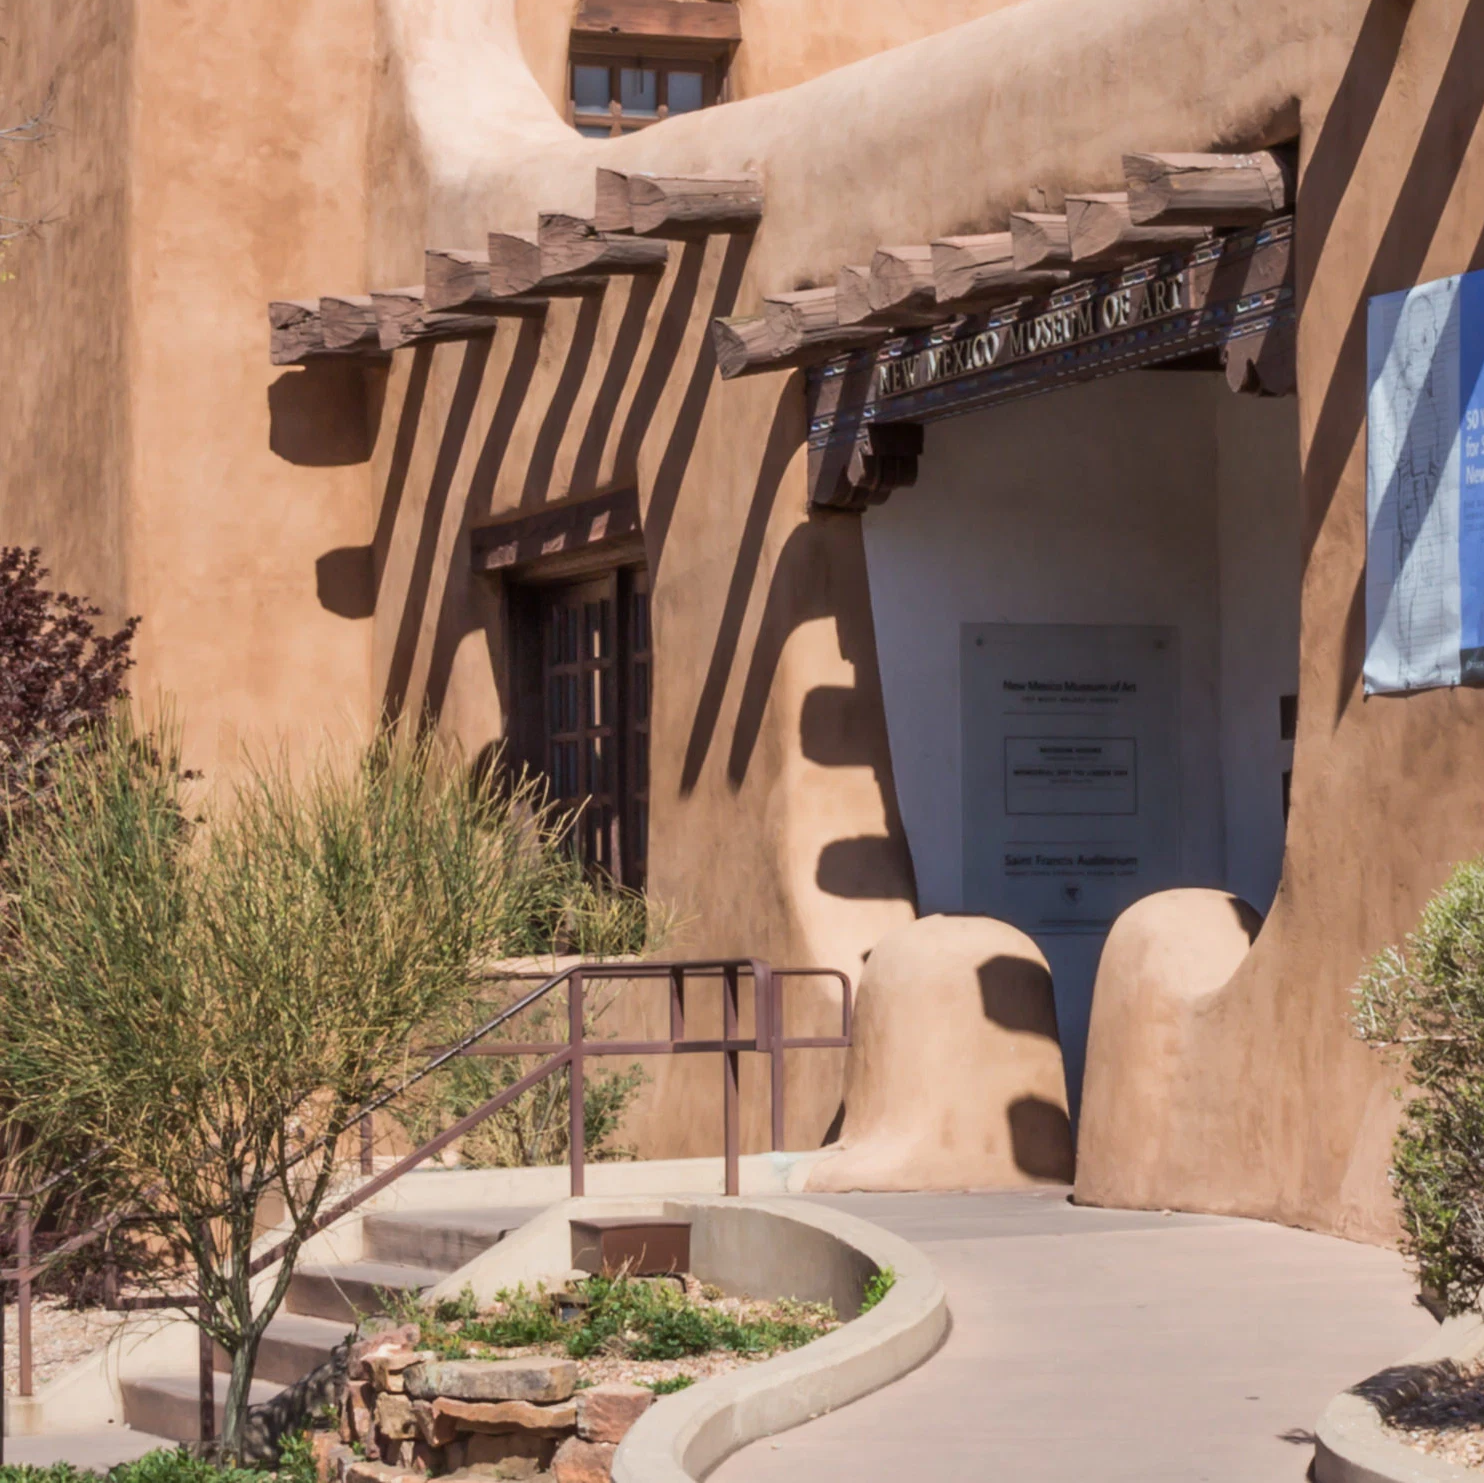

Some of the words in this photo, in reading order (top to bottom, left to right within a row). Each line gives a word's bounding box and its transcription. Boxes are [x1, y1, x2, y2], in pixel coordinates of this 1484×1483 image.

[879, 354, 920, 396] NEW
[927, 330, 1000, 382] MEXICO
[1008, 301, 1096, 357] MUSEUM
[1103, 288, 1131, 330] OF
[1140, 272, 1184, 320] ART
[1466, 408, 1479, 430] 50
[1465, 435, 1480, 458] for
[1003, 679, 1026, 692] New
[1027, 679, 1062, 692] Mexico
[1064, 679, 1108, 692] Museum
[1109, 678, 1121, 692] of
[1121, 679, 1137, 692] Art
[1004, 853, 1032, 866] Saint
